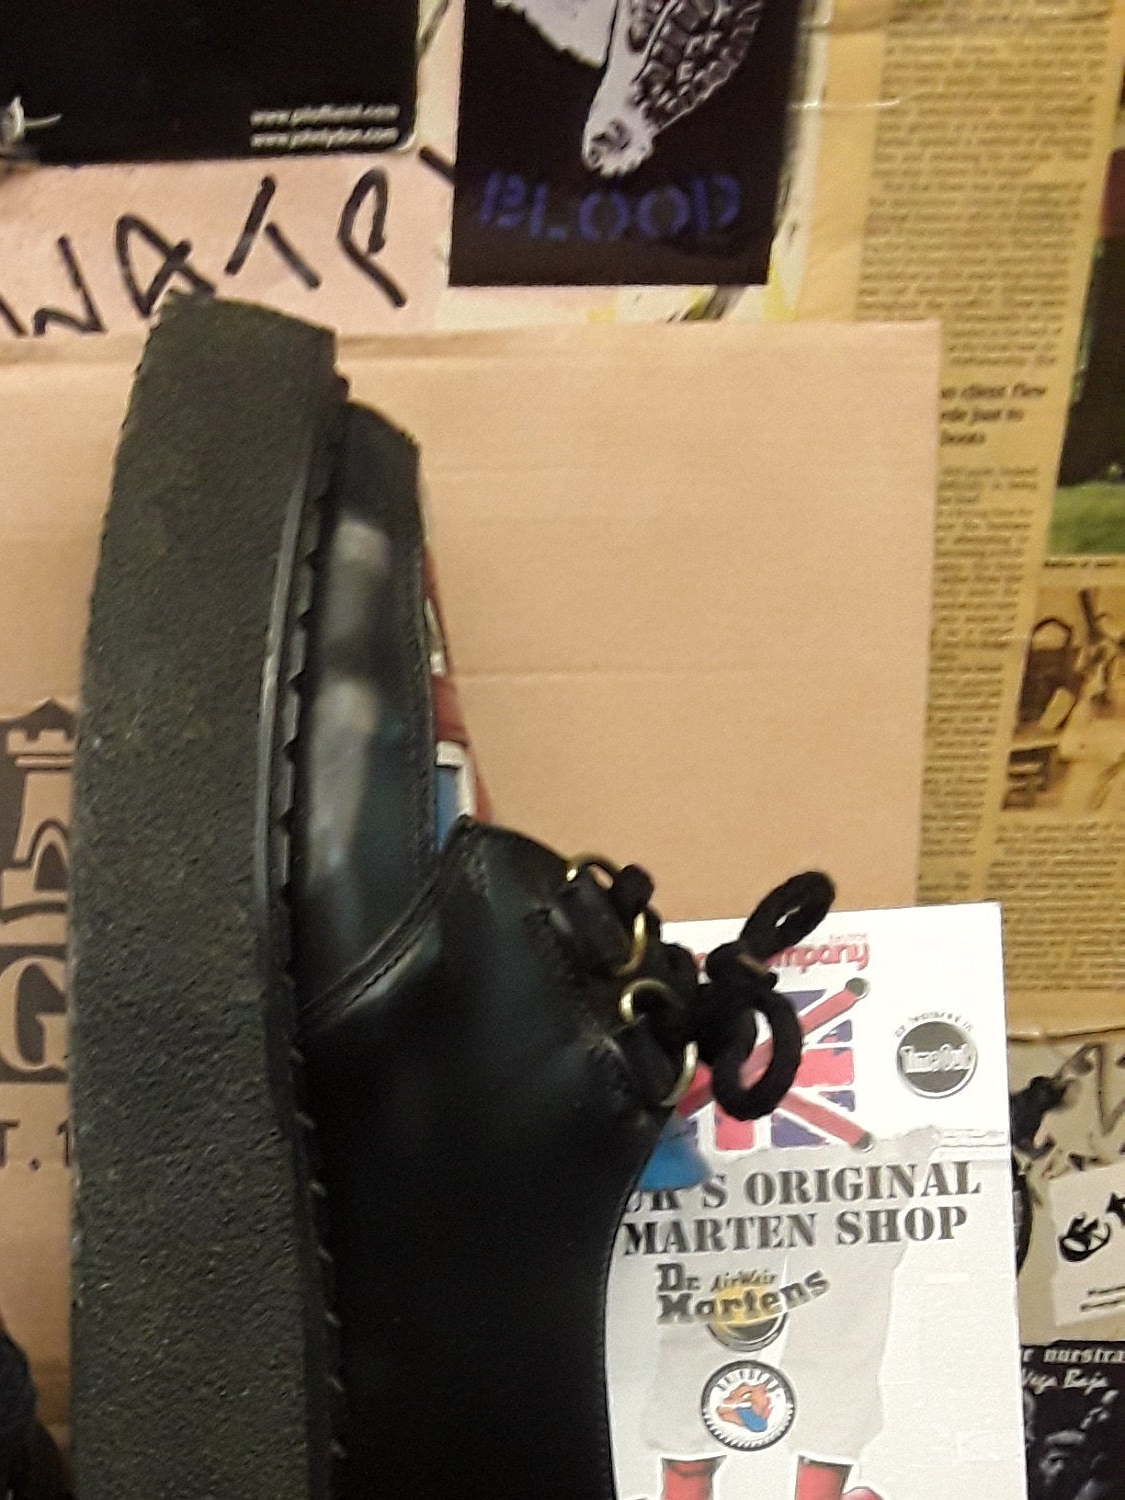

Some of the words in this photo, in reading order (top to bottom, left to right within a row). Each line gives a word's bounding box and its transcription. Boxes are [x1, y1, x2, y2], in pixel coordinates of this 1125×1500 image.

[478, 171, 742, 243] BLOOD
[744, 1160, 982, 1207] ORIGINAL
[622, 1212, 816, 1256] MARTEN
[836, 1204, 969, 1246] SHOP
[657, 1270, 830, 1323] Martens
